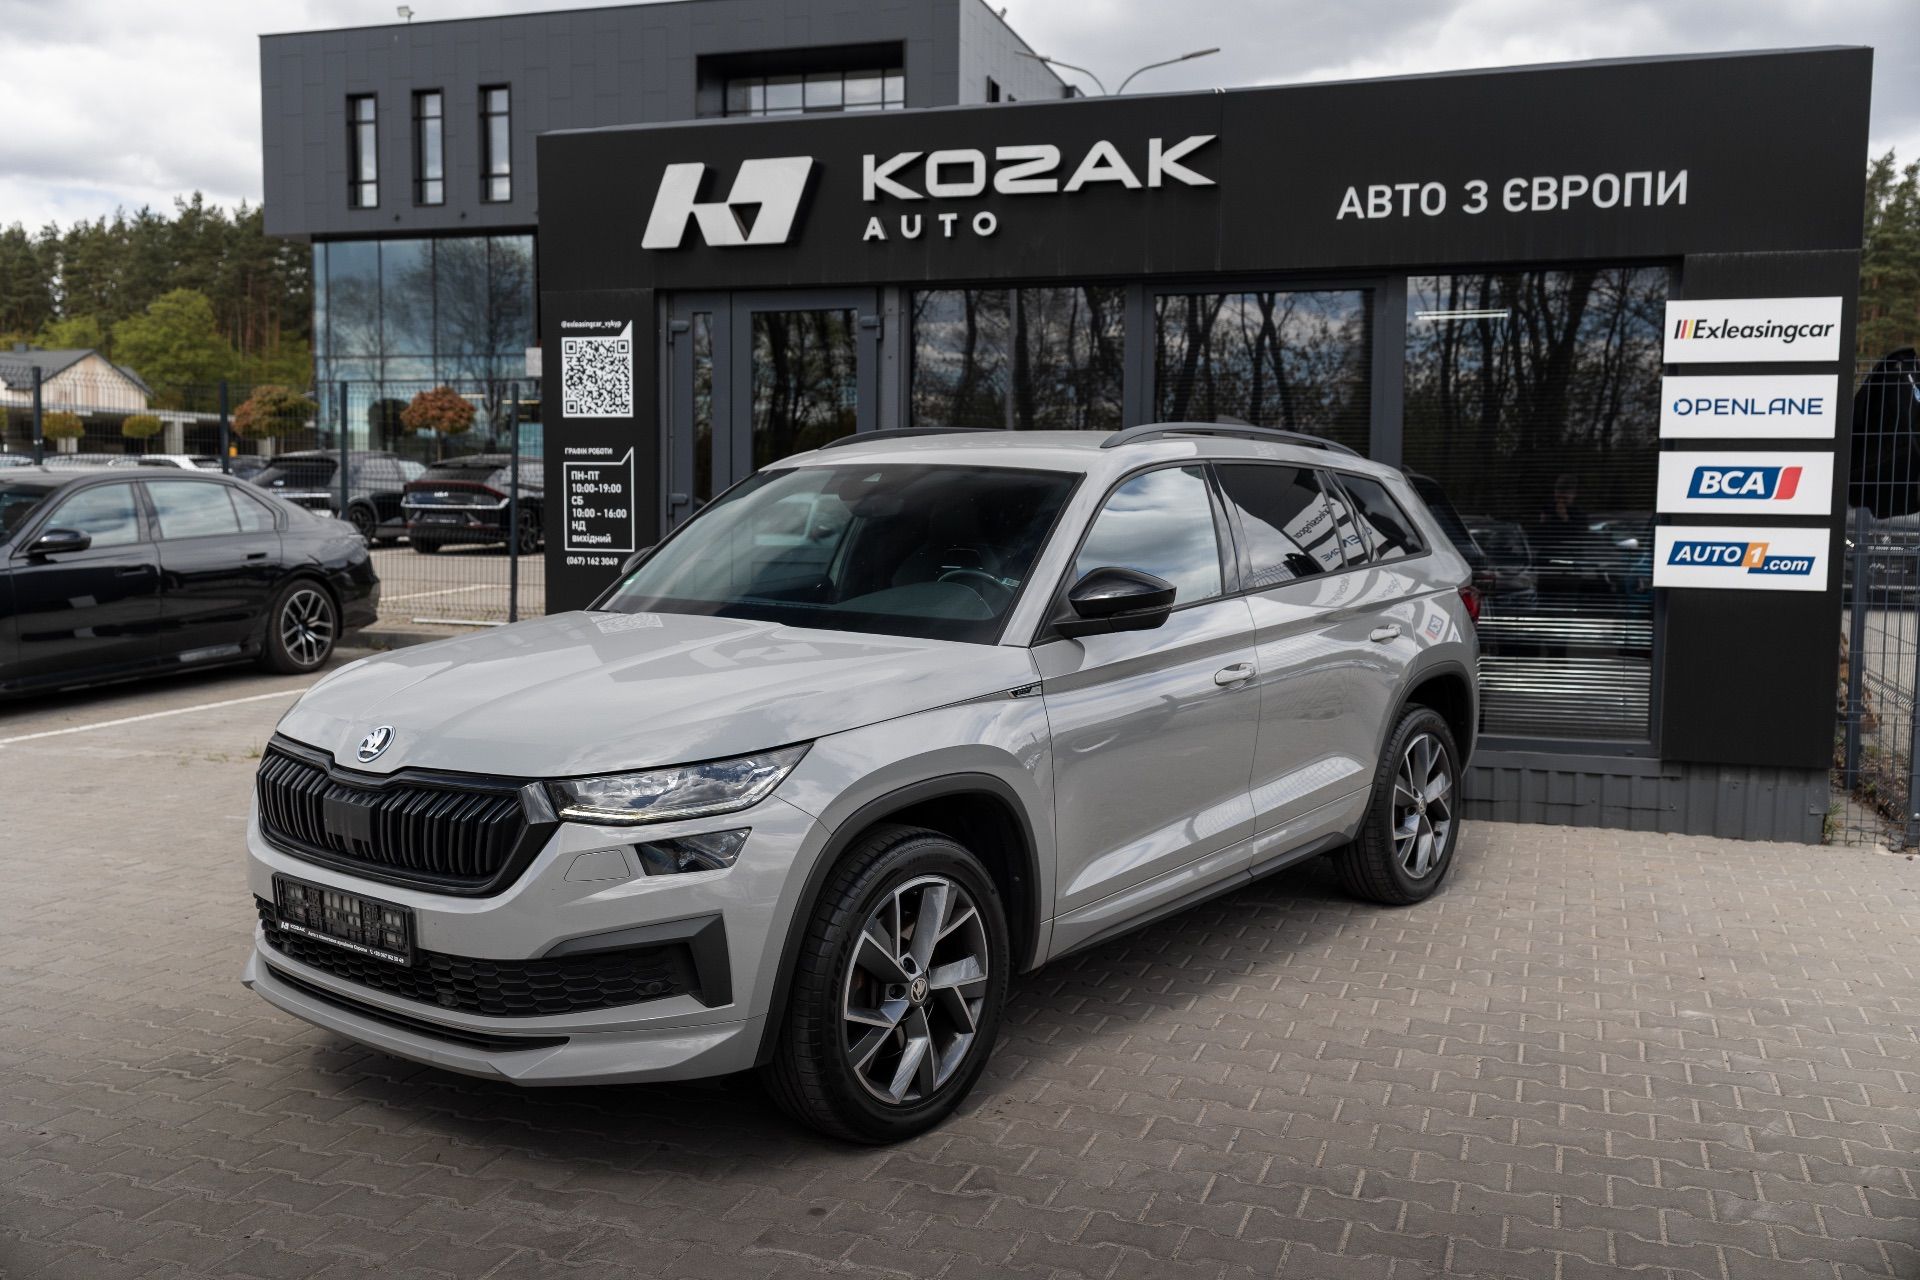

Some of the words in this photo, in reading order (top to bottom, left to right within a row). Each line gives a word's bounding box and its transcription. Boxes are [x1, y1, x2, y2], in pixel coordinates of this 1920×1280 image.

[863, 135, 1217, 201] KOZAK
[1336, 181, 1447, 220] АВТО
[1462, 179, 1488, 214] З
[1503, 169, 1688, 213] ЄВРОПИ
[862, 211, 998, 241] AUTO
[1692, 318, 1835, 344] Exleasingcar
[1673, 397, 1824, 416] OPENLANE
[571, 470, 600, 481] ПН-ПТ
[572, 483, 622, 494] 10:00-19:00
[1698, 470, 1766, 495] BCA
[571, 495, 585, 506] СБ
[572, 508, 596, 518] 10:00
[603, 508, 628, 519] 16:00
[571, 520, 587, 532] НД
[571, 533, 612, 545] вихідний
[566, 556, 586, 566] (067)
[586, 556, 600, 566] 162
[600, 556, 619, 566] 3049
